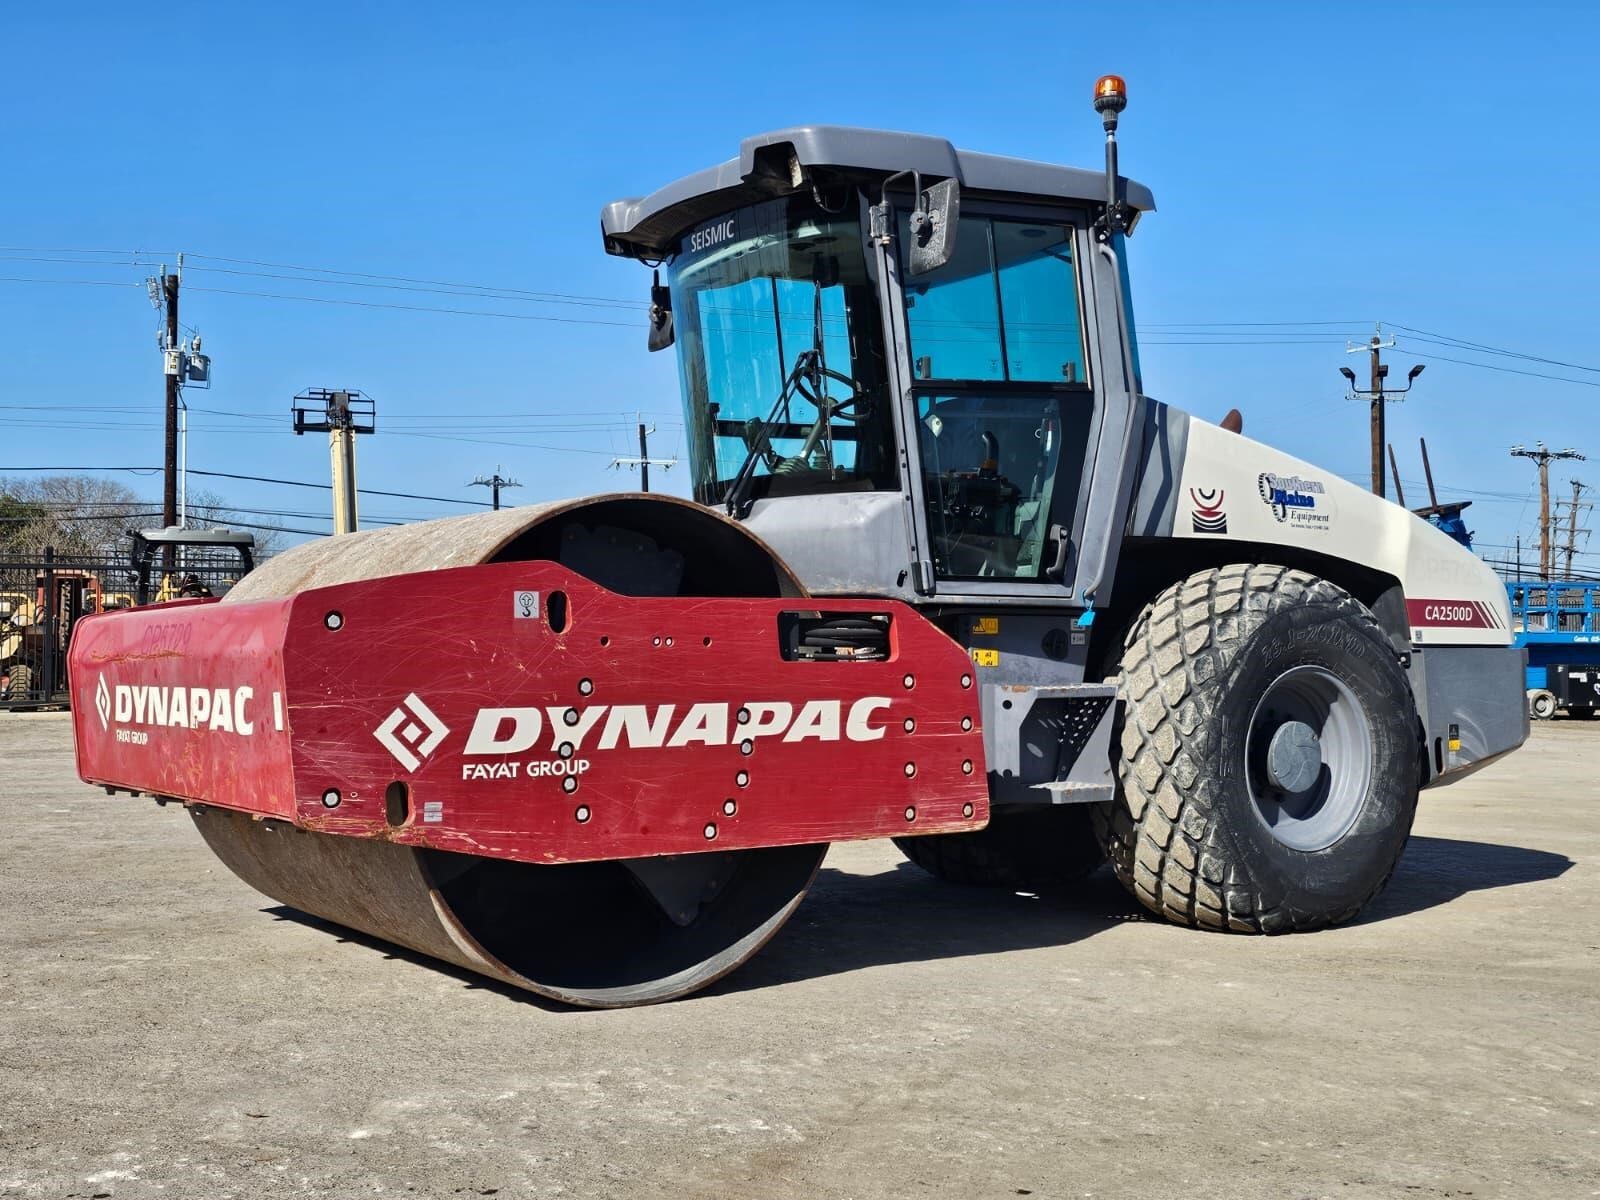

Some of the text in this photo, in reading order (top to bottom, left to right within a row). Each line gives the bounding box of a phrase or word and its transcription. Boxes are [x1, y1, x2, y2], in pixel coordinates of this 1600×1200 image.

[691, 220, 735, 252] SEISMIC
[1267, 473, 1326, 495] Southern
[1291, 510, 1329, 523] Equipment
[1425, 605, 1473, 621] CA2500D
[115, 685, 253, 736] DYNAPAC
[463, 697, 891, 755] DYNAPAC
[116, 729, 148, 745] FAYAT GROUP
[462, 759, 590, 780] FAYAT GROUP
